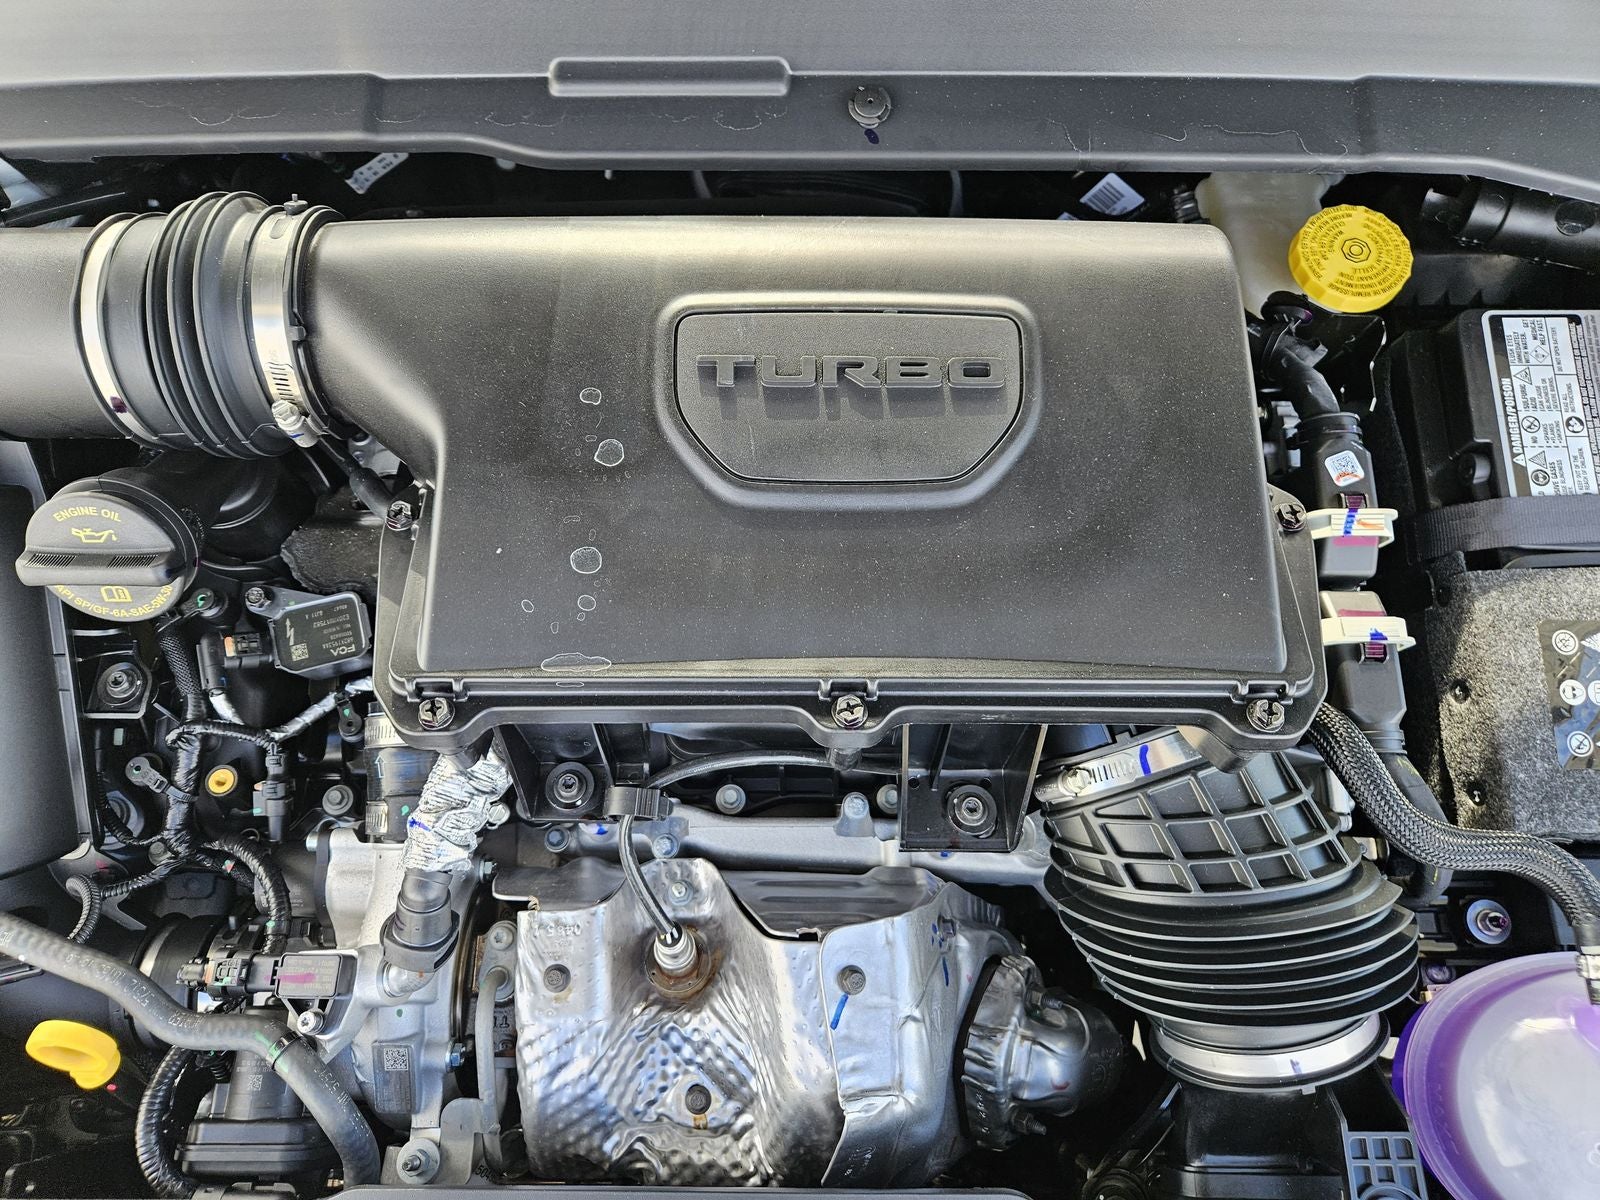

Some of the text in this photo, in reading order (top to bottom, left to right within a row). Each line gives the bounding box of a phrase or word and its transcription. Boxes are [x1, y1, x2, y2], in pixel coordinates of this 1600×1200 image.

[1530, 320, 1538, 340] MEDICAL
[1506, 335, 1516, 363] FLUSH EYES
[1513, 331, 1523, 363] IMMEDIATELY
[696, 354, 1006, 389] TURBO
[1520, 384, 1529, 409] SULFURIC
[1500, 378, 1523, 454] DANGER/POISON
[1531, 436, 1538, 444] NO
[1549, 461, 1557, 479] GASES
[53, 506, 122, 522] ENGINE OIL
[330, 644, 355, 656] FCA
